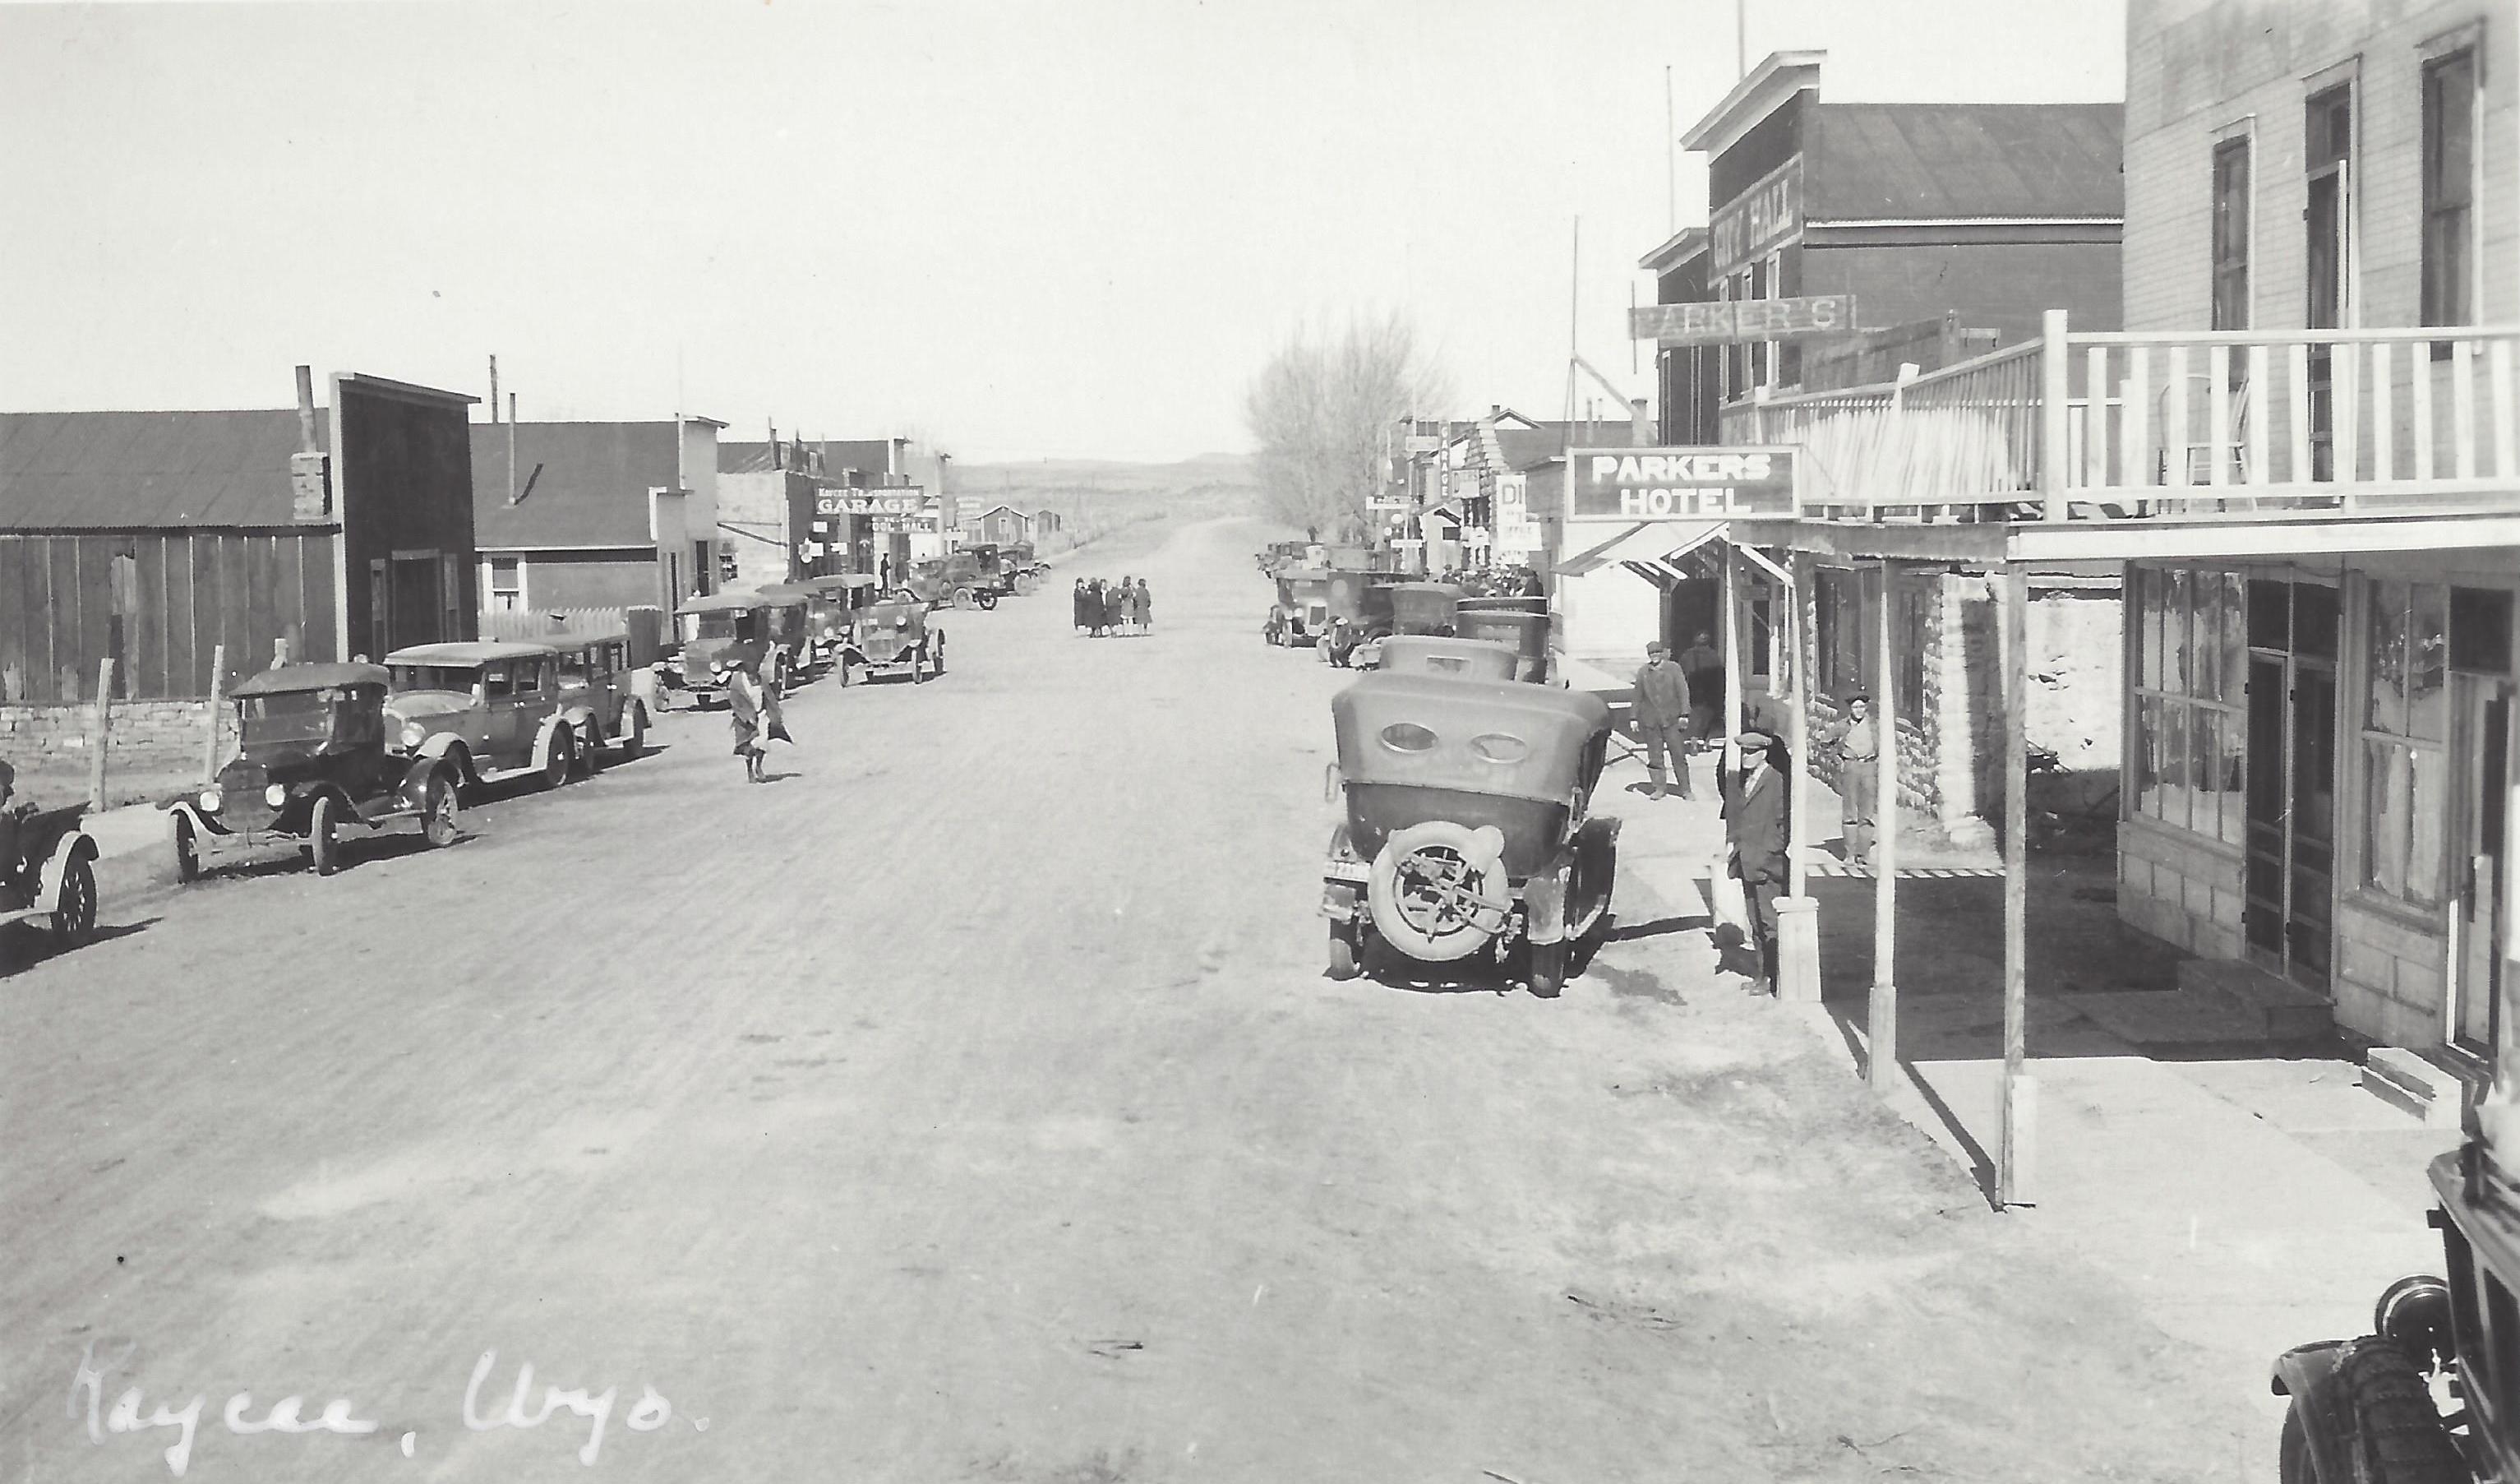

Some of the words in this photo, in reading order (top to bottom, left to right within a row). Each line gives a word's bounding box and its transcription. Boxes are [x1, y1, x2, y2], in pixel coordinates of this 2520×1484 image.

[1749, 178, 1793, 250] HALL
[1440, 426, 1449, 497] GARAGE
[1591, 454, 1772, 485] PARKERS
[817, 498, 921, 515] GARAGE
[1619, 488, 1753, 515] HOTEL
[902, 521, 932, 533] HALL
